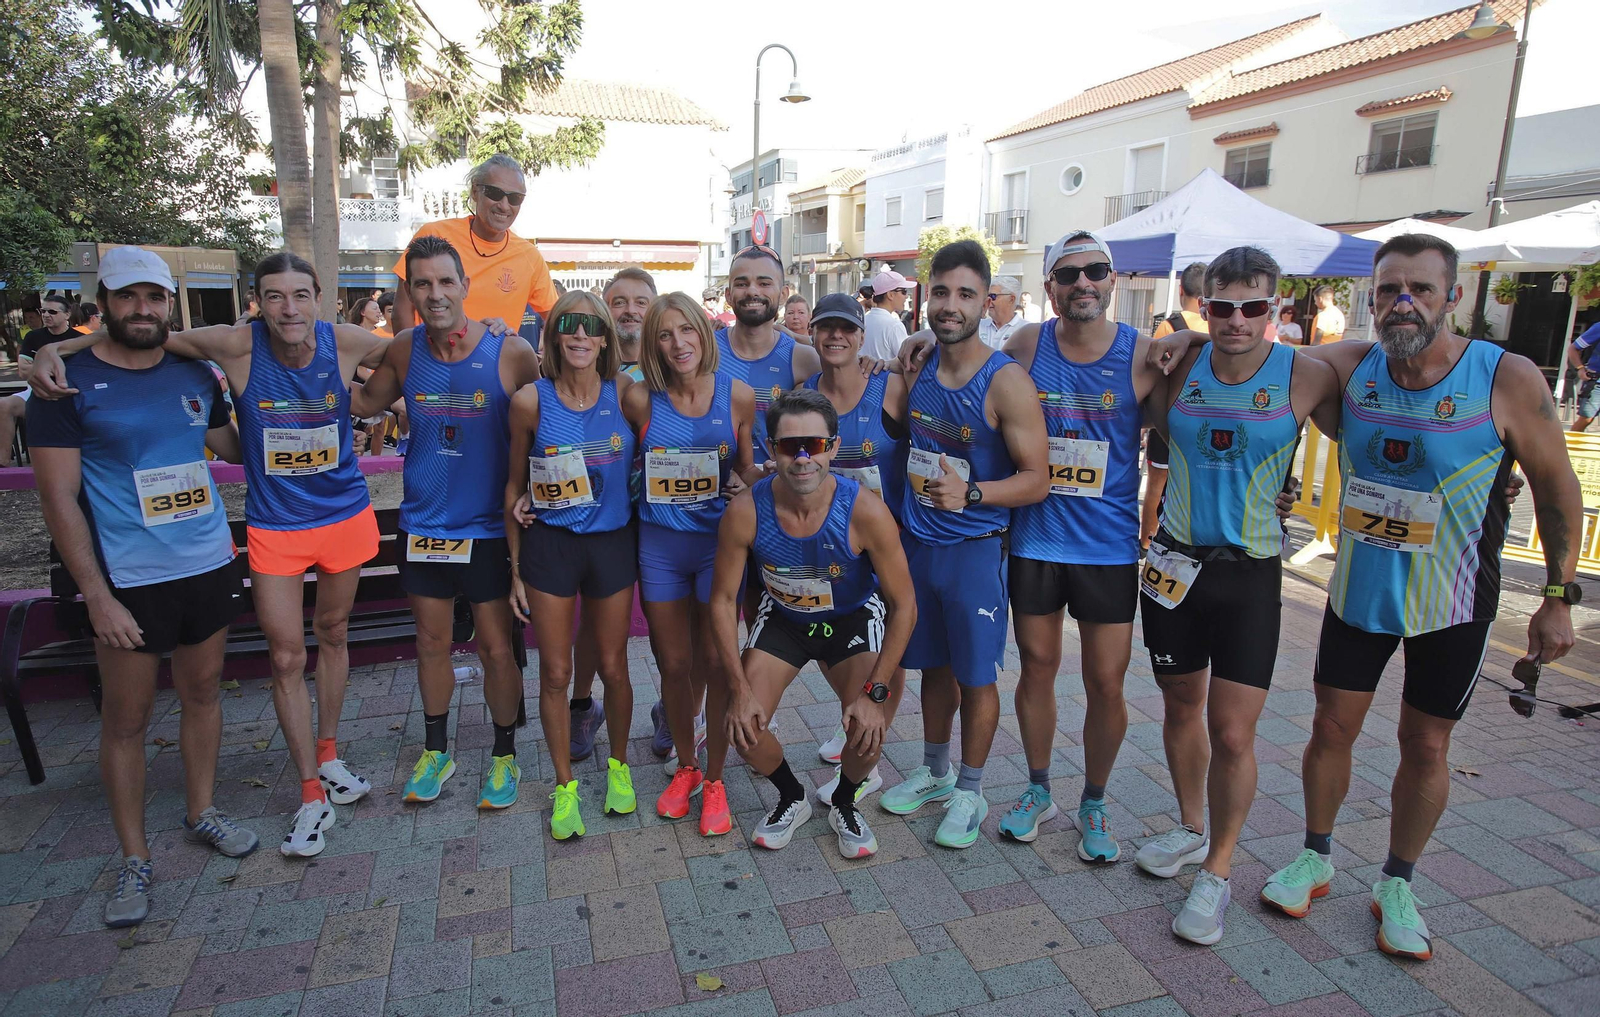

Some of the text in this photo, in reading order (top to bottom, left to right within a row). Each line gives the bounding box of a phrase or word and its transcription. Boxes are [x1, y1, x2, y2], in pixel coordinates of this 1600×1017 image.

[274, 449, 328, 465] 241
[536, 480, 579, 498] 191
[657, 478, 712, 493] 190
[151, 488, 206, 512] 393
[1362, 512, 1409, 537] 75
[414, 537, 465, 552] 427
[916, 784, 938, 794] KIPRUN
